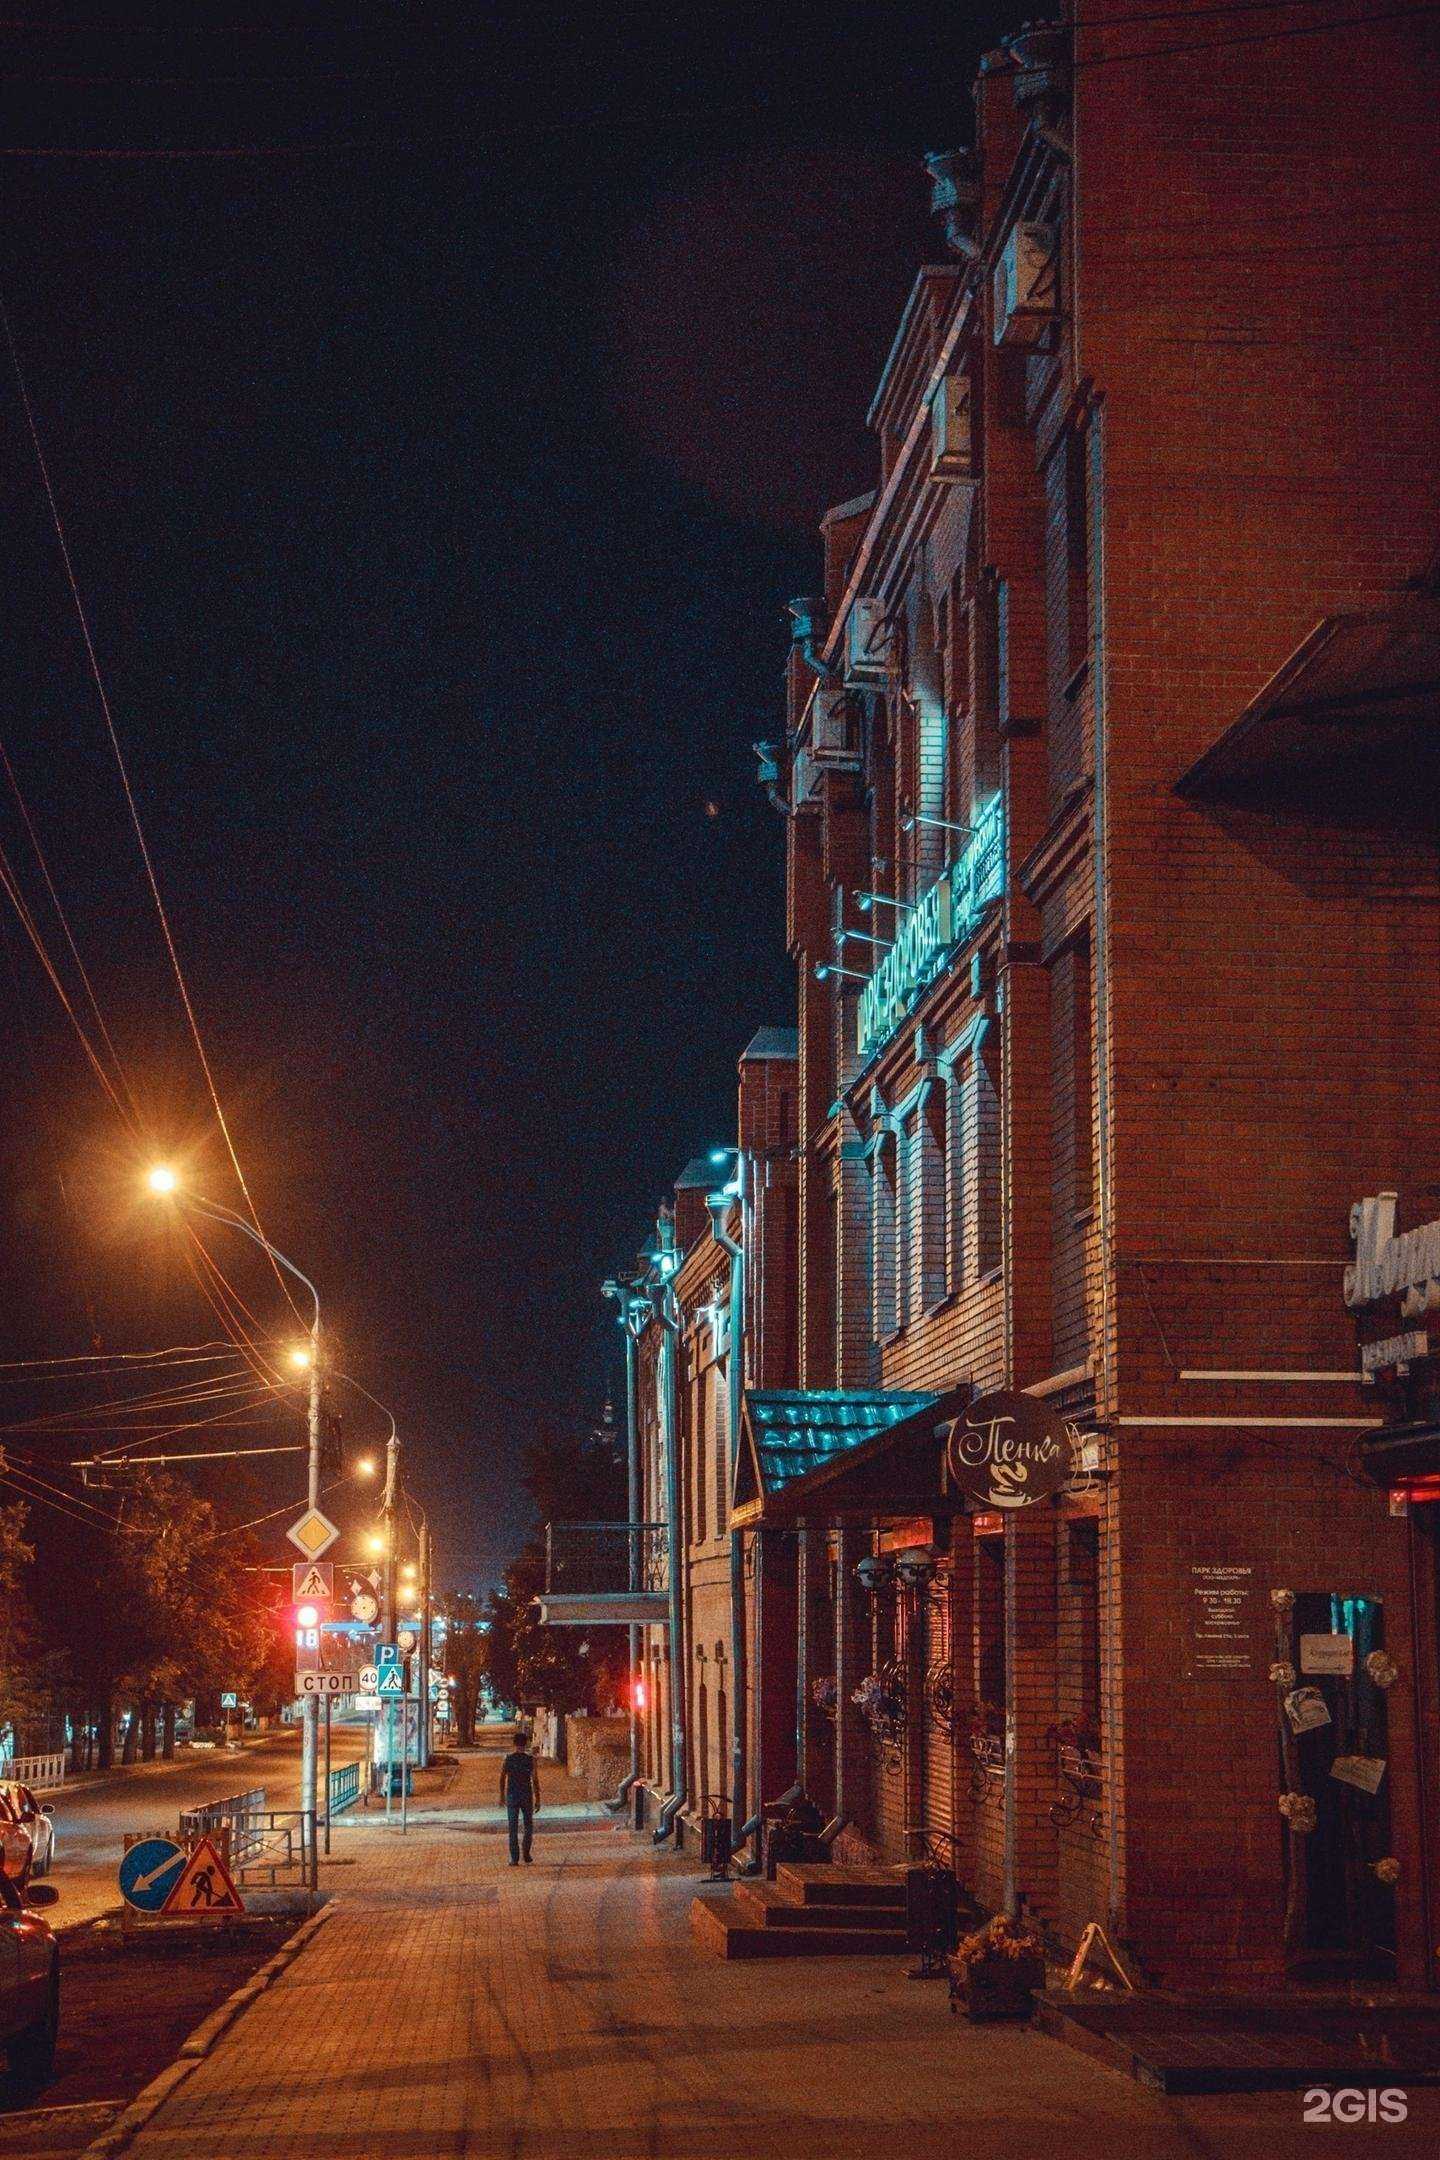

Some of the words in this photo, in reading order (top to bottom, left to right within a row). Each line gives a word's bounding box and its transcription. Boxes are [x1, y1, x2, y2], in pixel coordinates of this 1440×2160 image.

[959, 1416, 1060, 1466] Пенка
[1192, 1566, 1211, 1575] ПАРК
[1212, 1566, 1252, 1575] ЗДОРОВЬЯ
[304, 1676, 352, 1691] СТОП
[362, 1672, 378, 1683] 40
